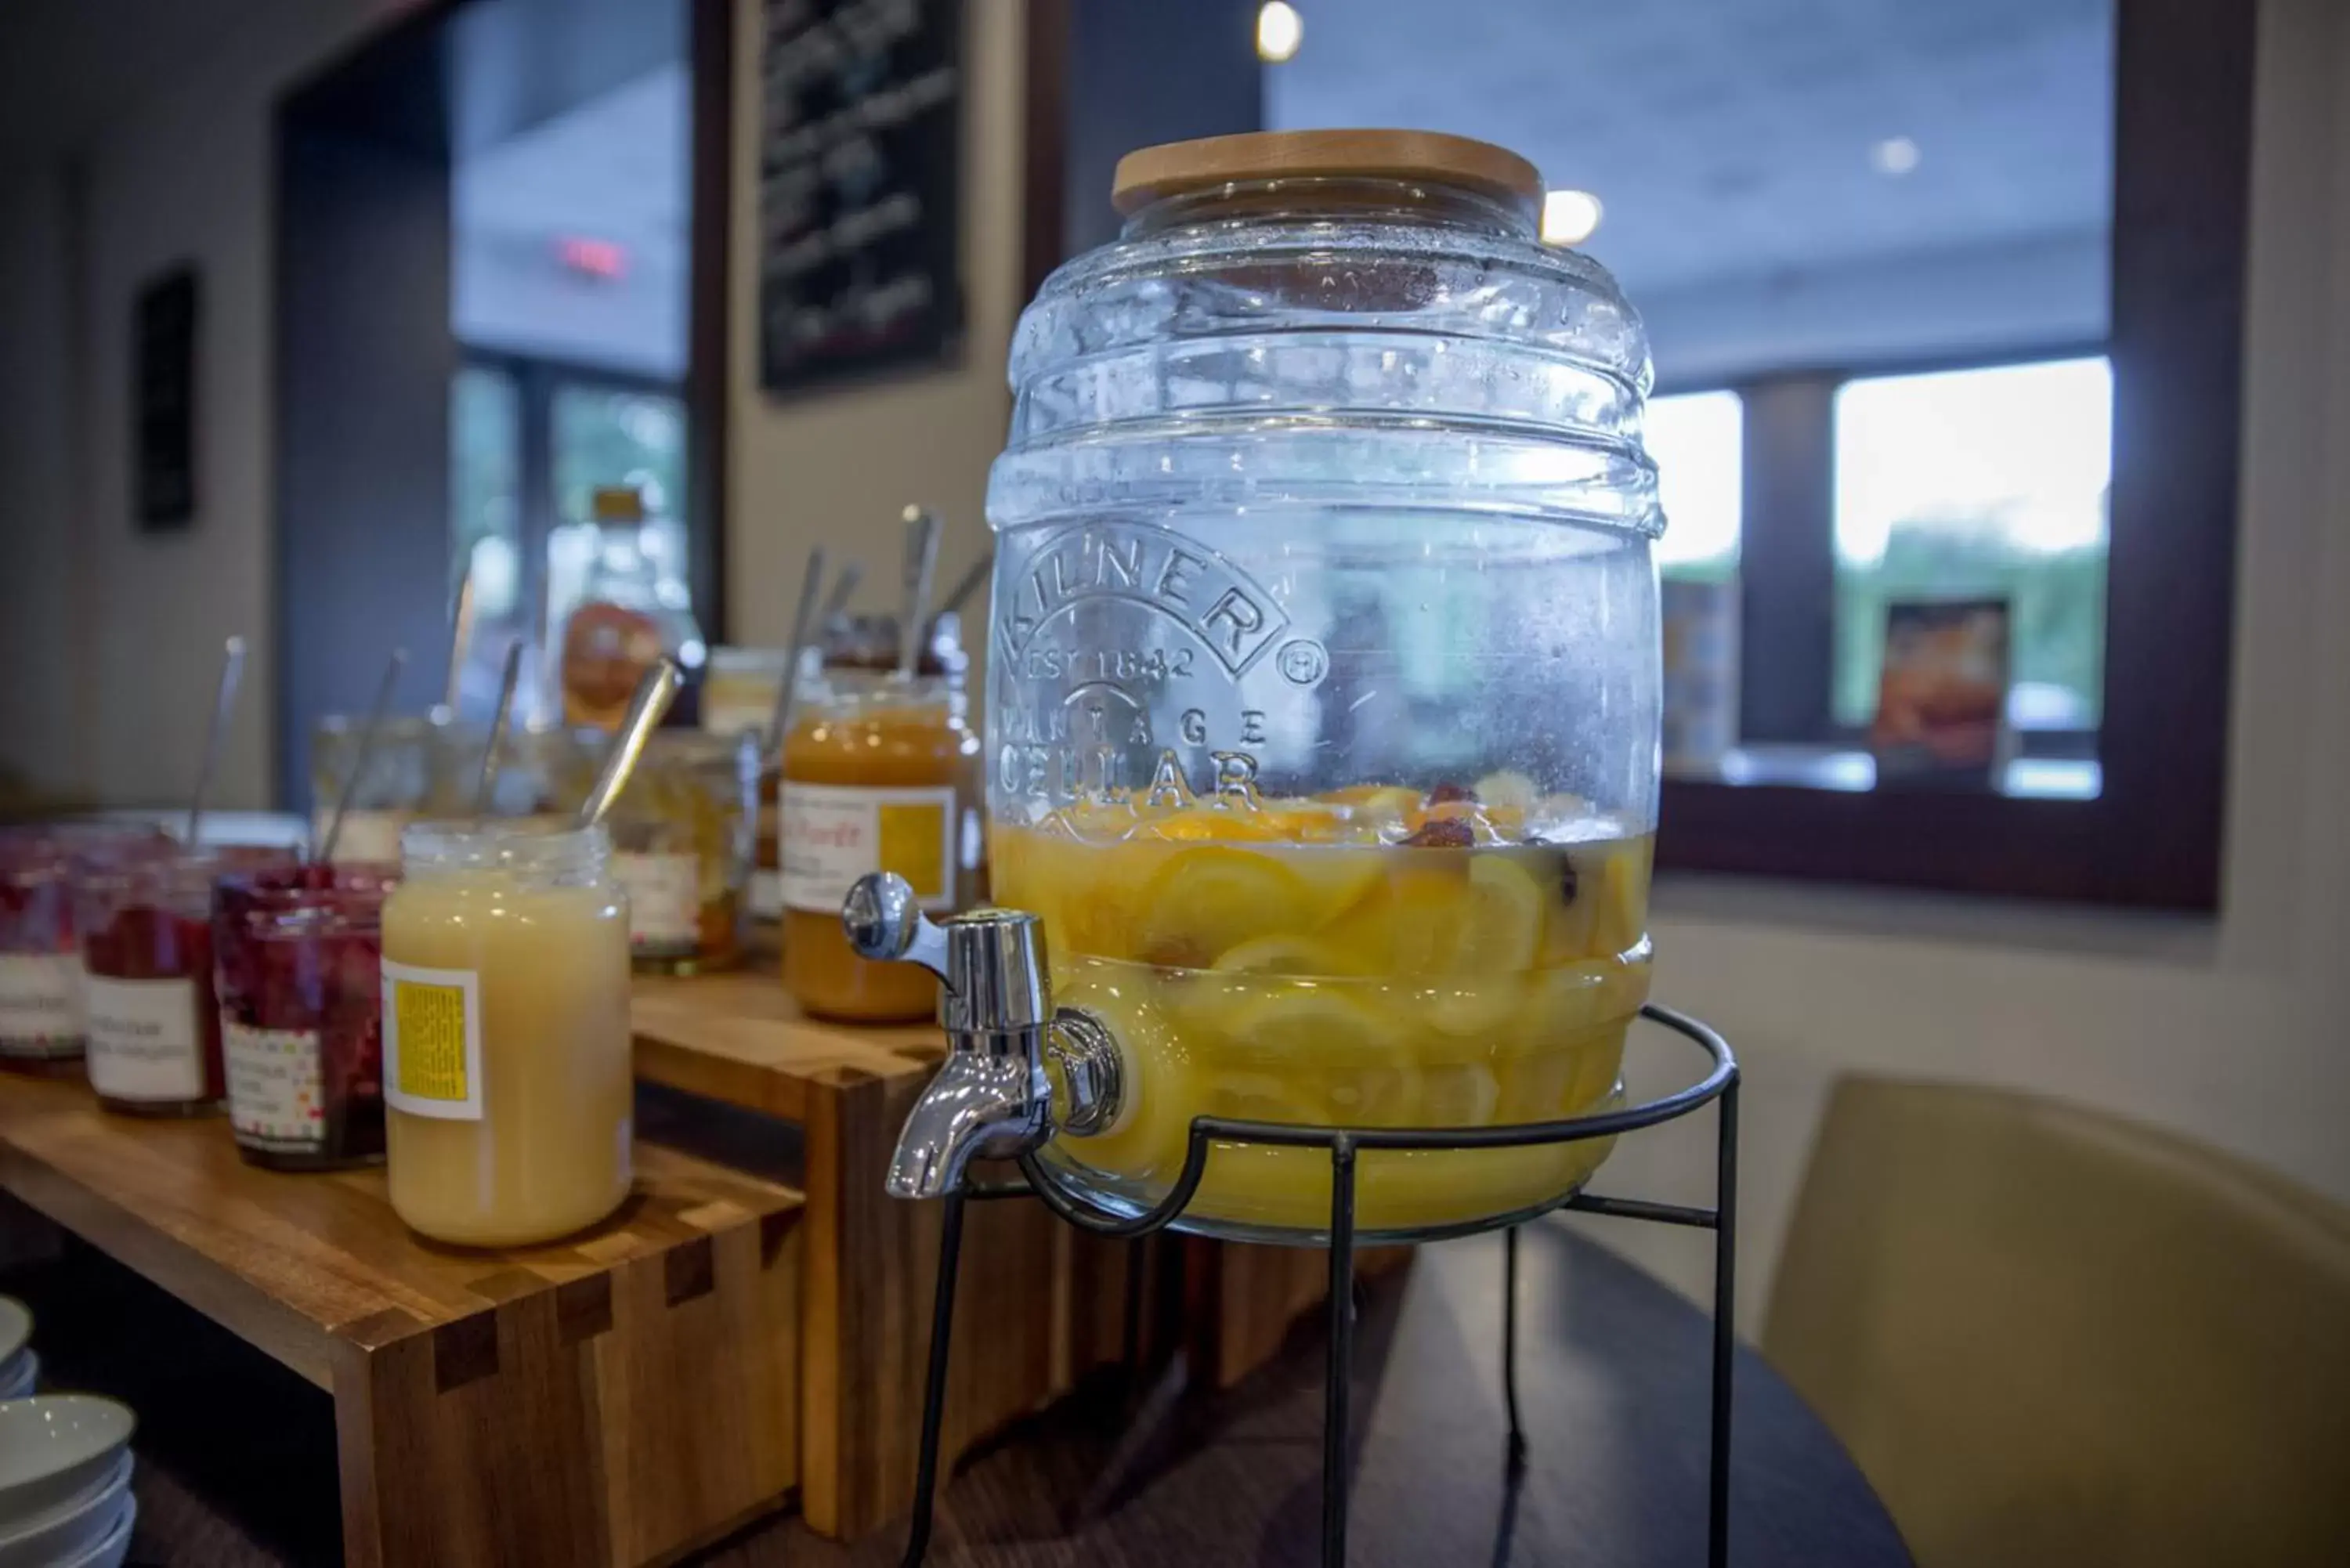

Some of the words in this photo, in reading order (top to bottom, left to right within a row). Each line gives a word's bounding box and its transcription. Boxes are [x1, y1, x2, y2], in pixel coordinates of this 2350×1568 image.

[1000, 539, 1264, 661] KILNER
[1027, 649, 1078, 679] EST
[1097, 648, 1195, 680] 1842
